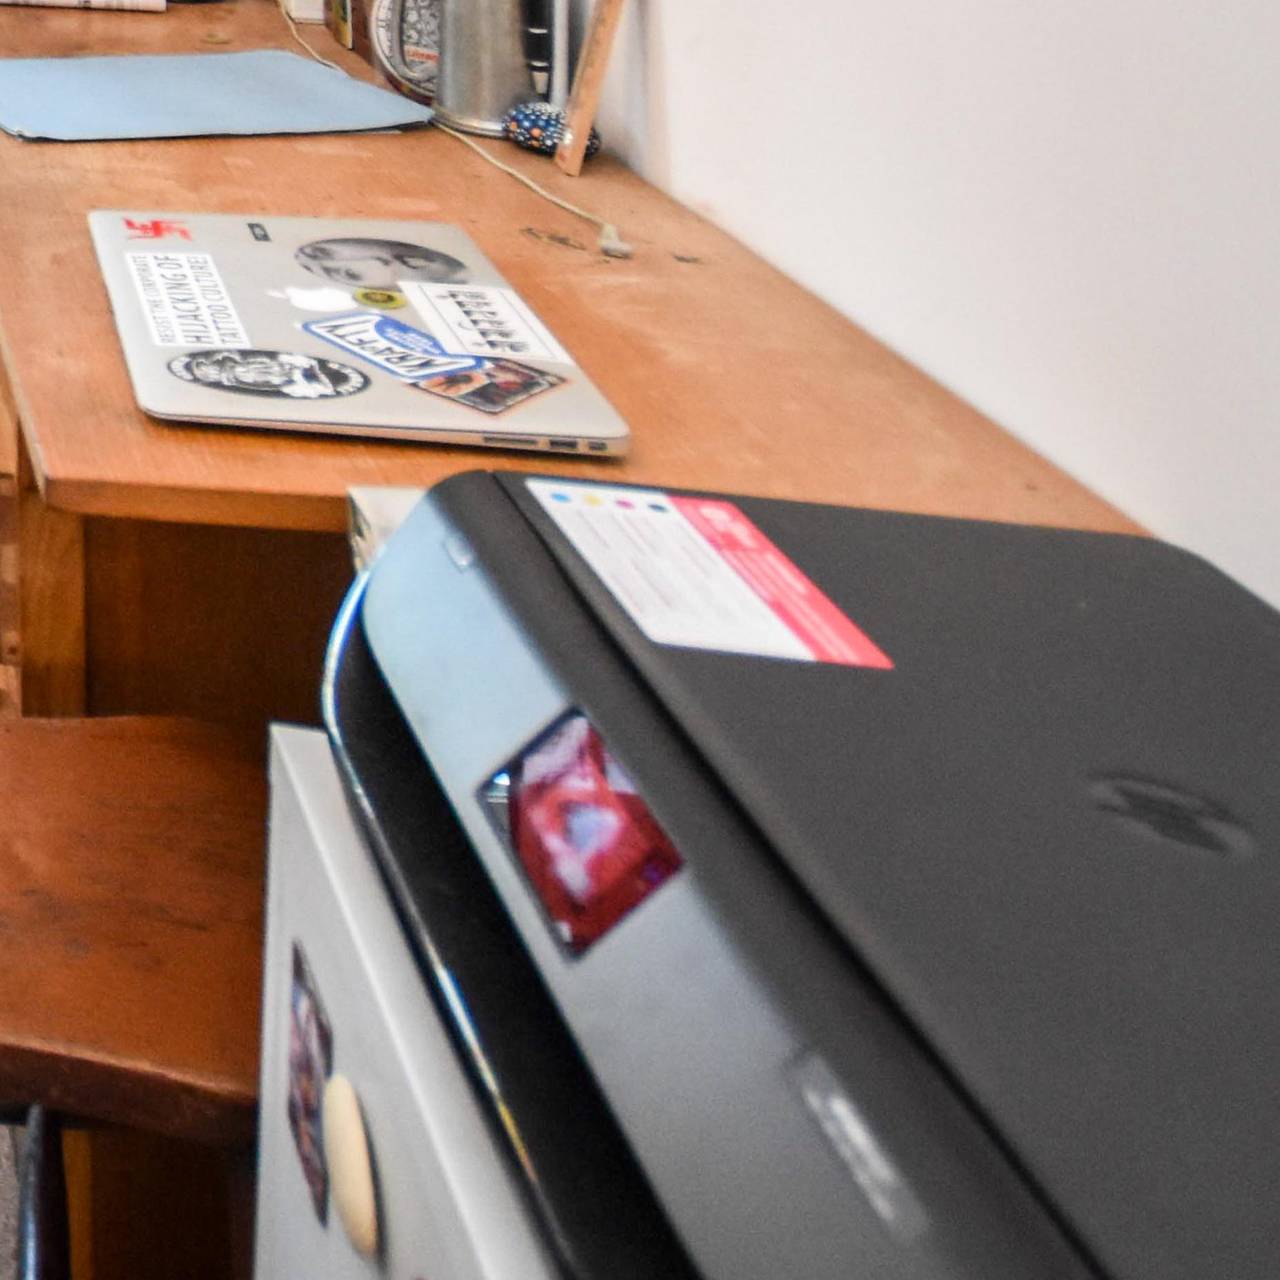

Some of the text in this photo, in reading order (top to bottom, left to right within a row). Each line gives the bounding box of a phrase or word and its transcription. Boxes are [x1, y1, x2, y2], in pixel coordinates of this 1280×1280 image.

[153, 255, 183, 270] OF
[160, 273, 214, 344] HIJACKING
[207, 304, 243, 344] TATTOO
